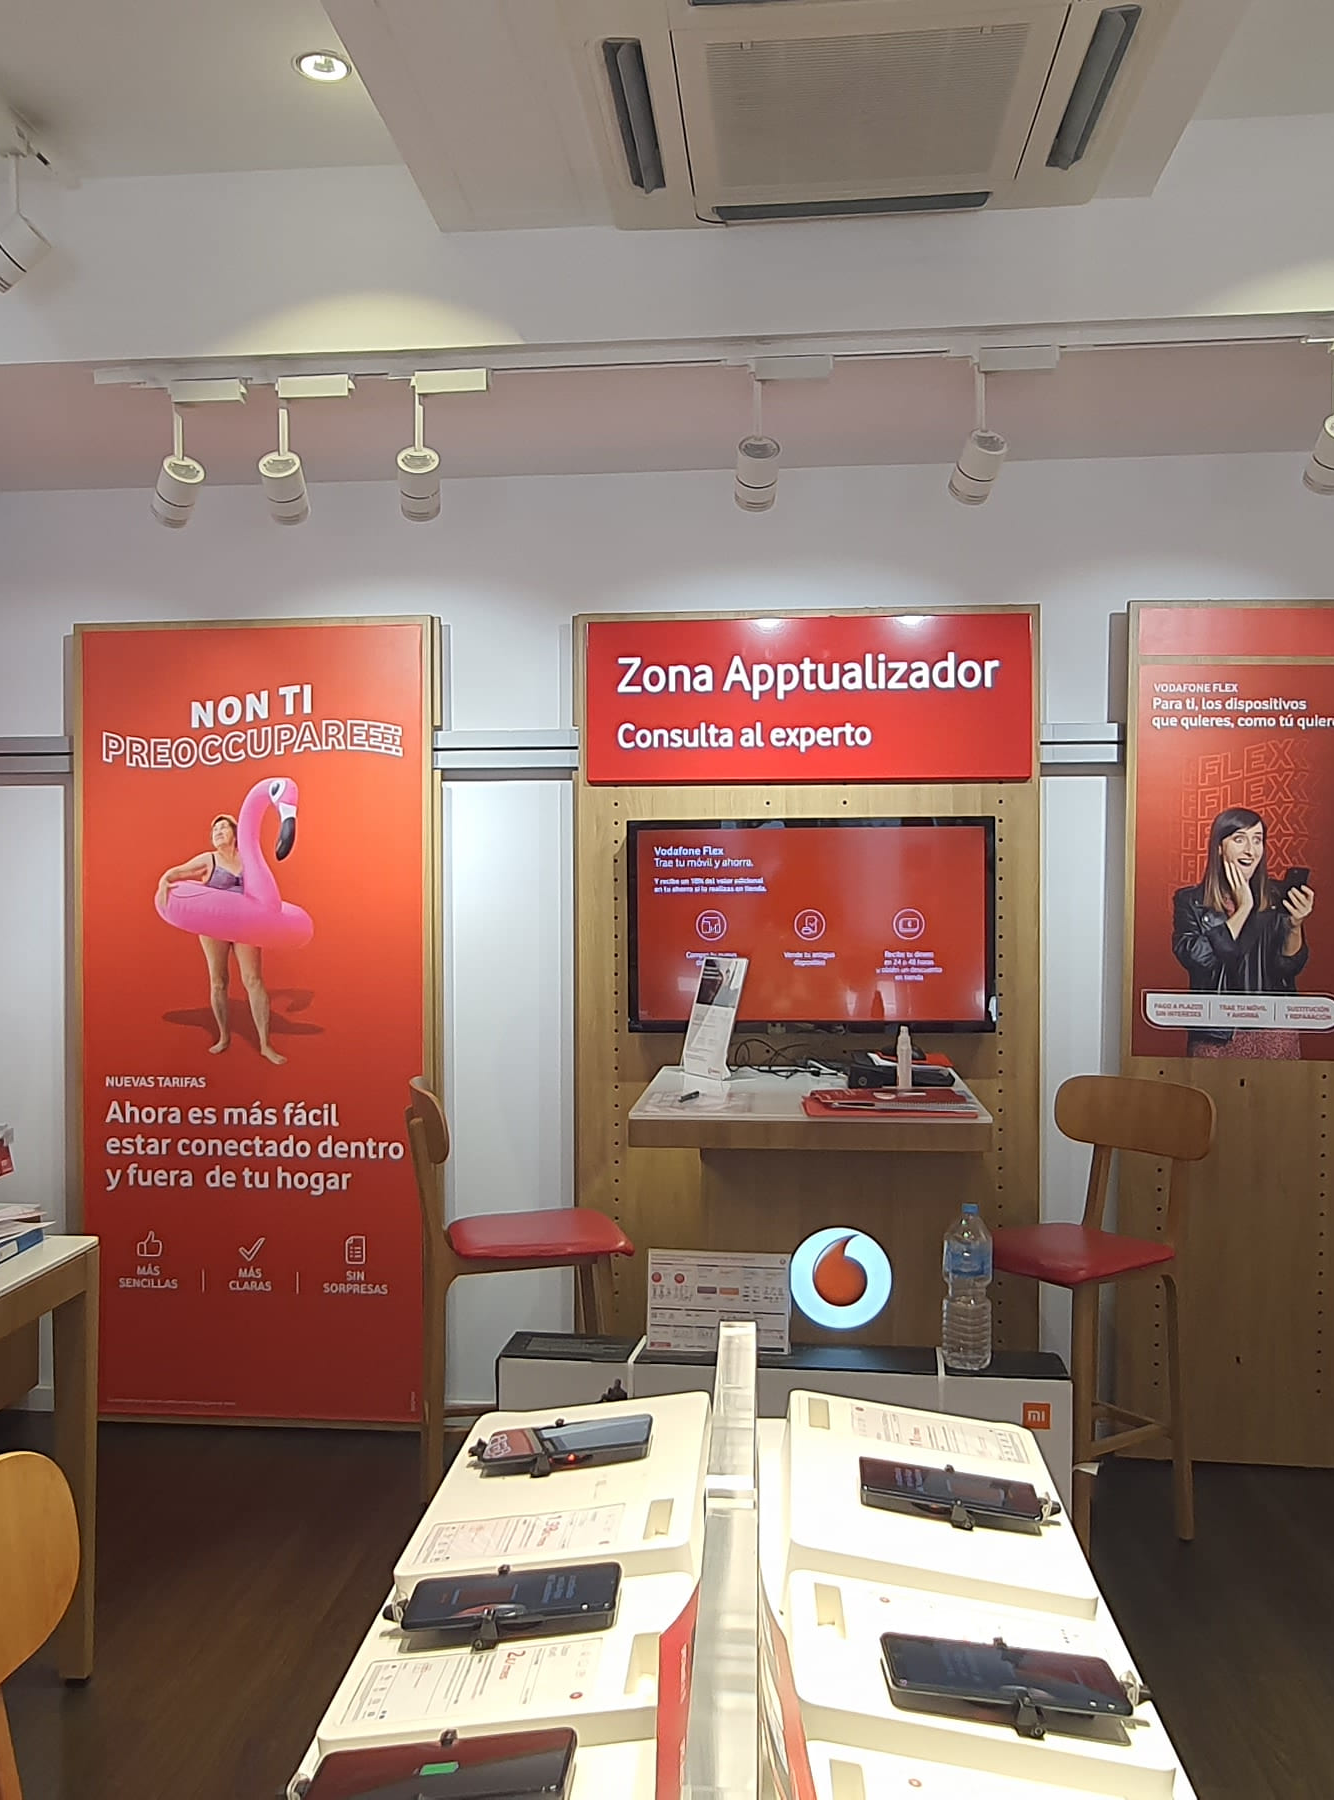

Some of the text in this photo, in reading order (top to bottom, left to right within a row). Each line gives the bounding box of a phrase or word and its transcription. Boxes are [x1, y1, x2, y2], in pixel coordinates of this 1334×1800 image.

[616, 651, 1000, 701] Zona Apptualizador
[1154, 683, 1238, 693] VODAFONE FLEX
[190, 684, 313, 728] NON TI
[1153, 697, 1307, 713] Para ti, los dispositivos
[1152, 715, 1178, 730] que
[1181, 714, 1235, 730] quieres,
[1237, 716, 1276, 728] como
[1279, 715, 1294, 728] tú
[616, 722, 873, 752] Consulta al experto
[1198, 738, 1296, 786] FLEX
[654, 846, 724, 856] Vodafone Flex
[654, 857, 674, 868] Trae
[675, 858, 686, 868] tu
[687, 857, 714, 868] móvil
[714, 859, 721, 870] y
[105, 1076, 206, 1088] NUEVAS TARIFAS
[105, 1100, 340, 1127] Ahora es más fácil
[105, 1134, 406, 1160] estar conectado dentro
[105, 1163, 352, 1196] y fuera de tu hogar
[136, 1263, 161, 1276] MÁS
[238, 1266, 263, 1279] MÁS
[345, 1270, 366, 1282] SIN
[119, 1277, 179, 1289] SENCILLAS
[228, 1279, 272, 1292] CLARAS
[322, 1282, 389, 1295] SORPRESAS
